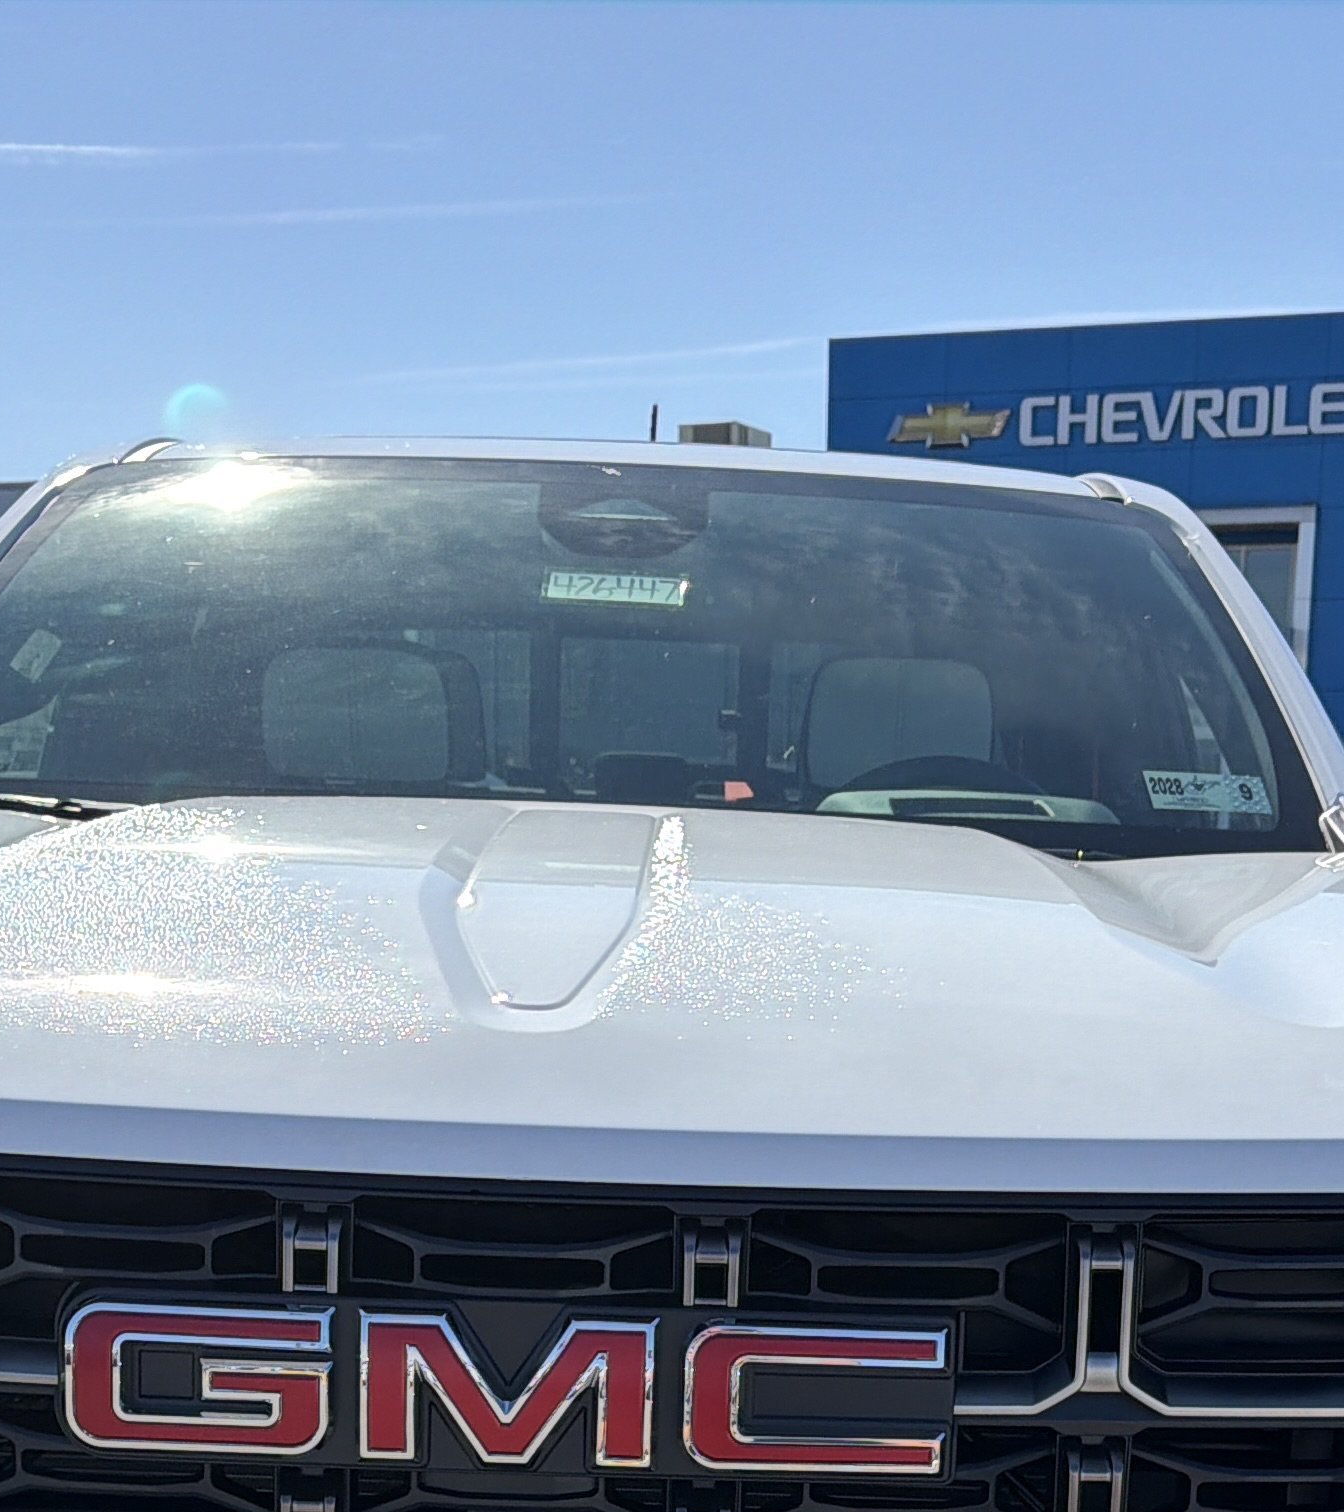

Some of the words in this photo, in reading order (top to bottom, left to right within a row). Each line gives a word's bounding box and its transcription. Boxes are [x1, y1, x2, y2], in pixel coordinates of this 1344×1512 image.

[554, 575, 677, 602] 426447
[1149, 777, 1184, 796] 2028
[1238, 783, 1253, 801] 9
[64, 1301, 948, 1474] GMC
